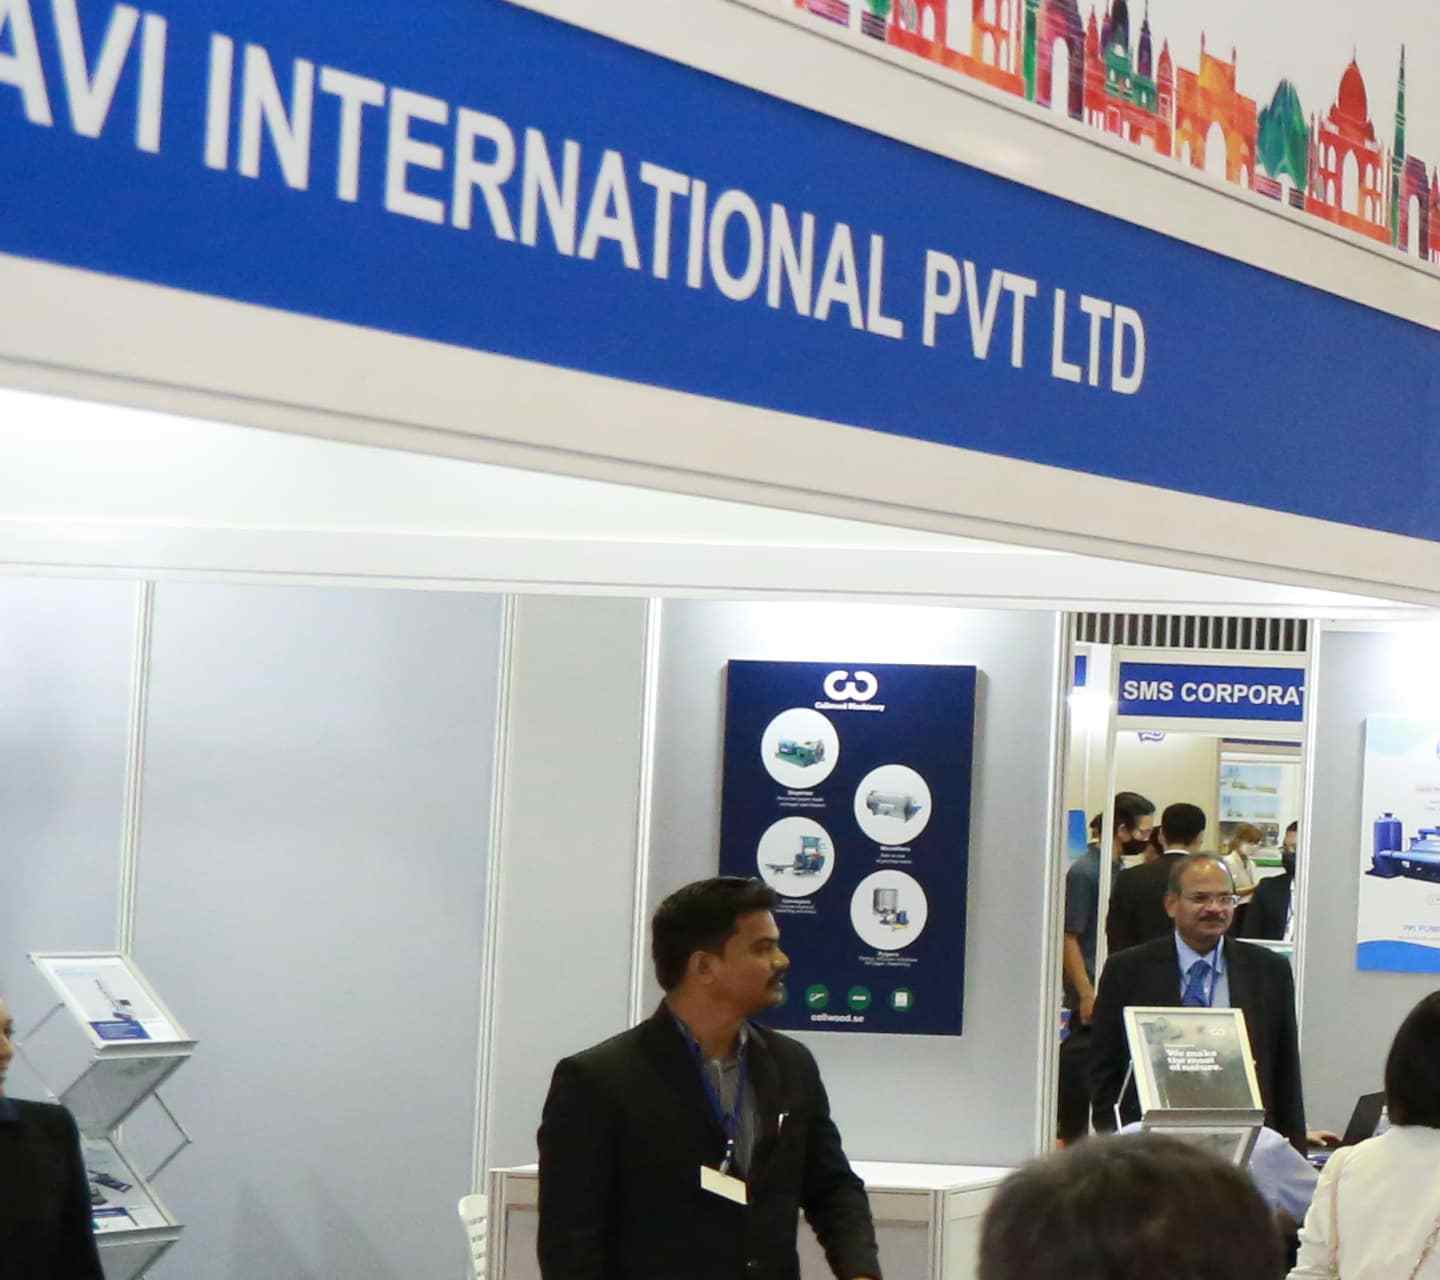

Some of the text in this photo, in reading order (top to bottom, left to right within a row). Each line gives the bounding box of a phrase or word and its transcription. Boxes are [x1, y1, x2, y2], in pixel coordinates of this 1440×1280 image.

[205, 41, 1145, 397] INTERNATIONAL PVT LTD
[1123, 681, 1173, 701] SMS
